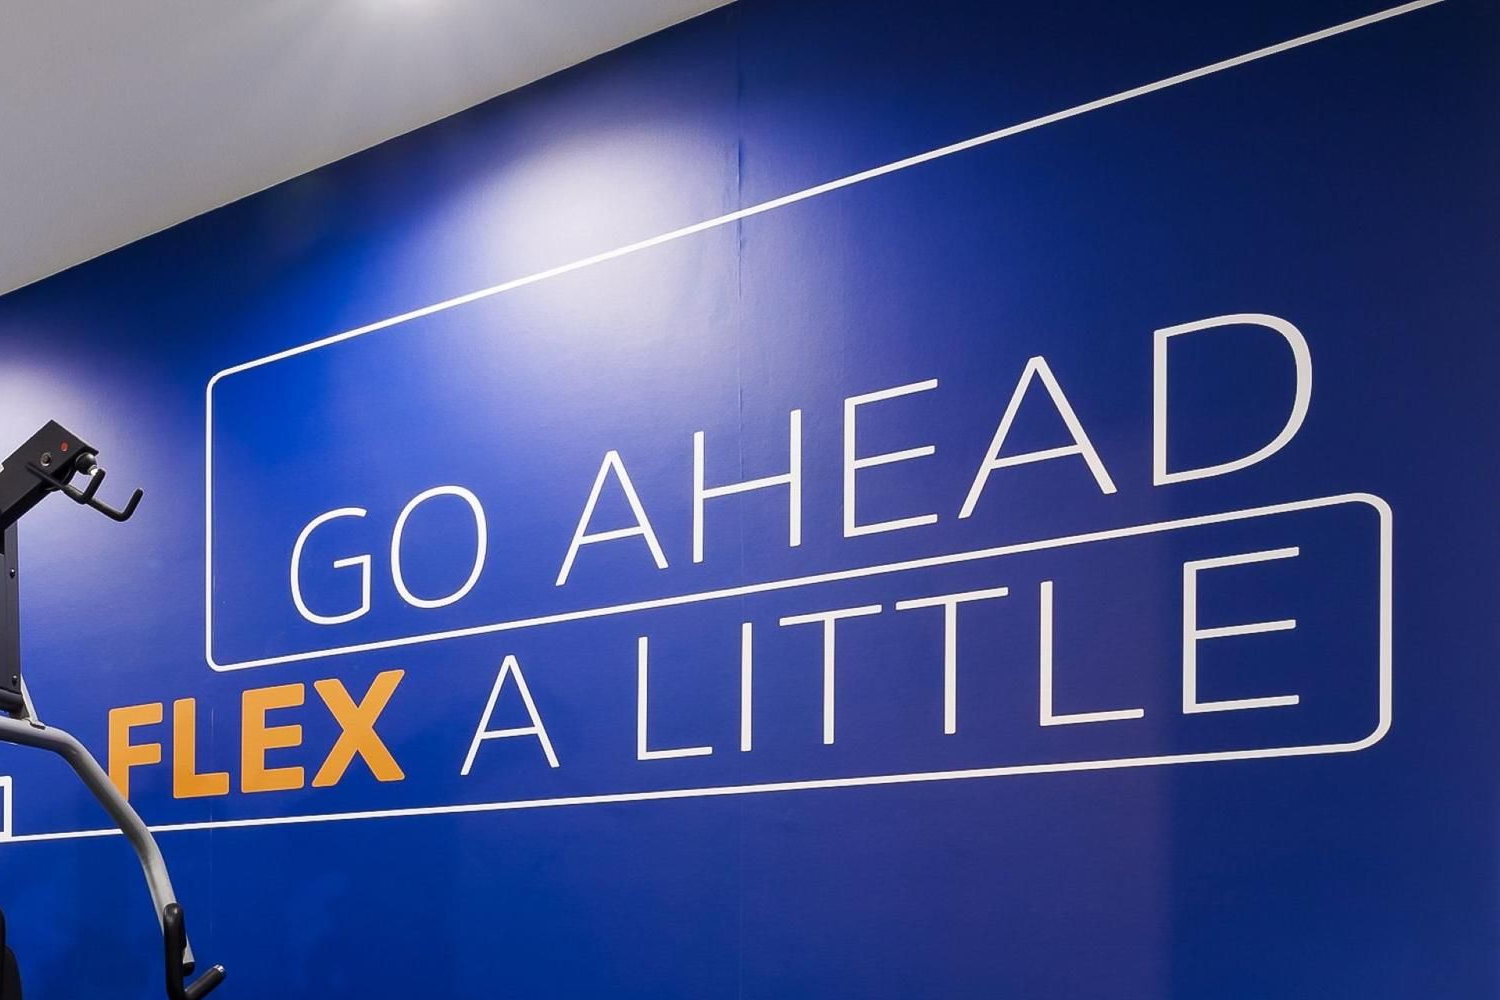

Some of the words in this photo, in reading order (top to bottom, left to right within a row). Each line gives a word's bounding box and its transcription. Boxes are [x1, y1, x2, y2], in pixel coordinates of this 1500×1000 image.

[290, 485, 487, 625] GO
[555, 311, 1312, 587] AHEAD
[107, 668, 406, 801] FLEX
[460, 654, 560, 776] A
[637, 546, 1299, 760] LITTLE
